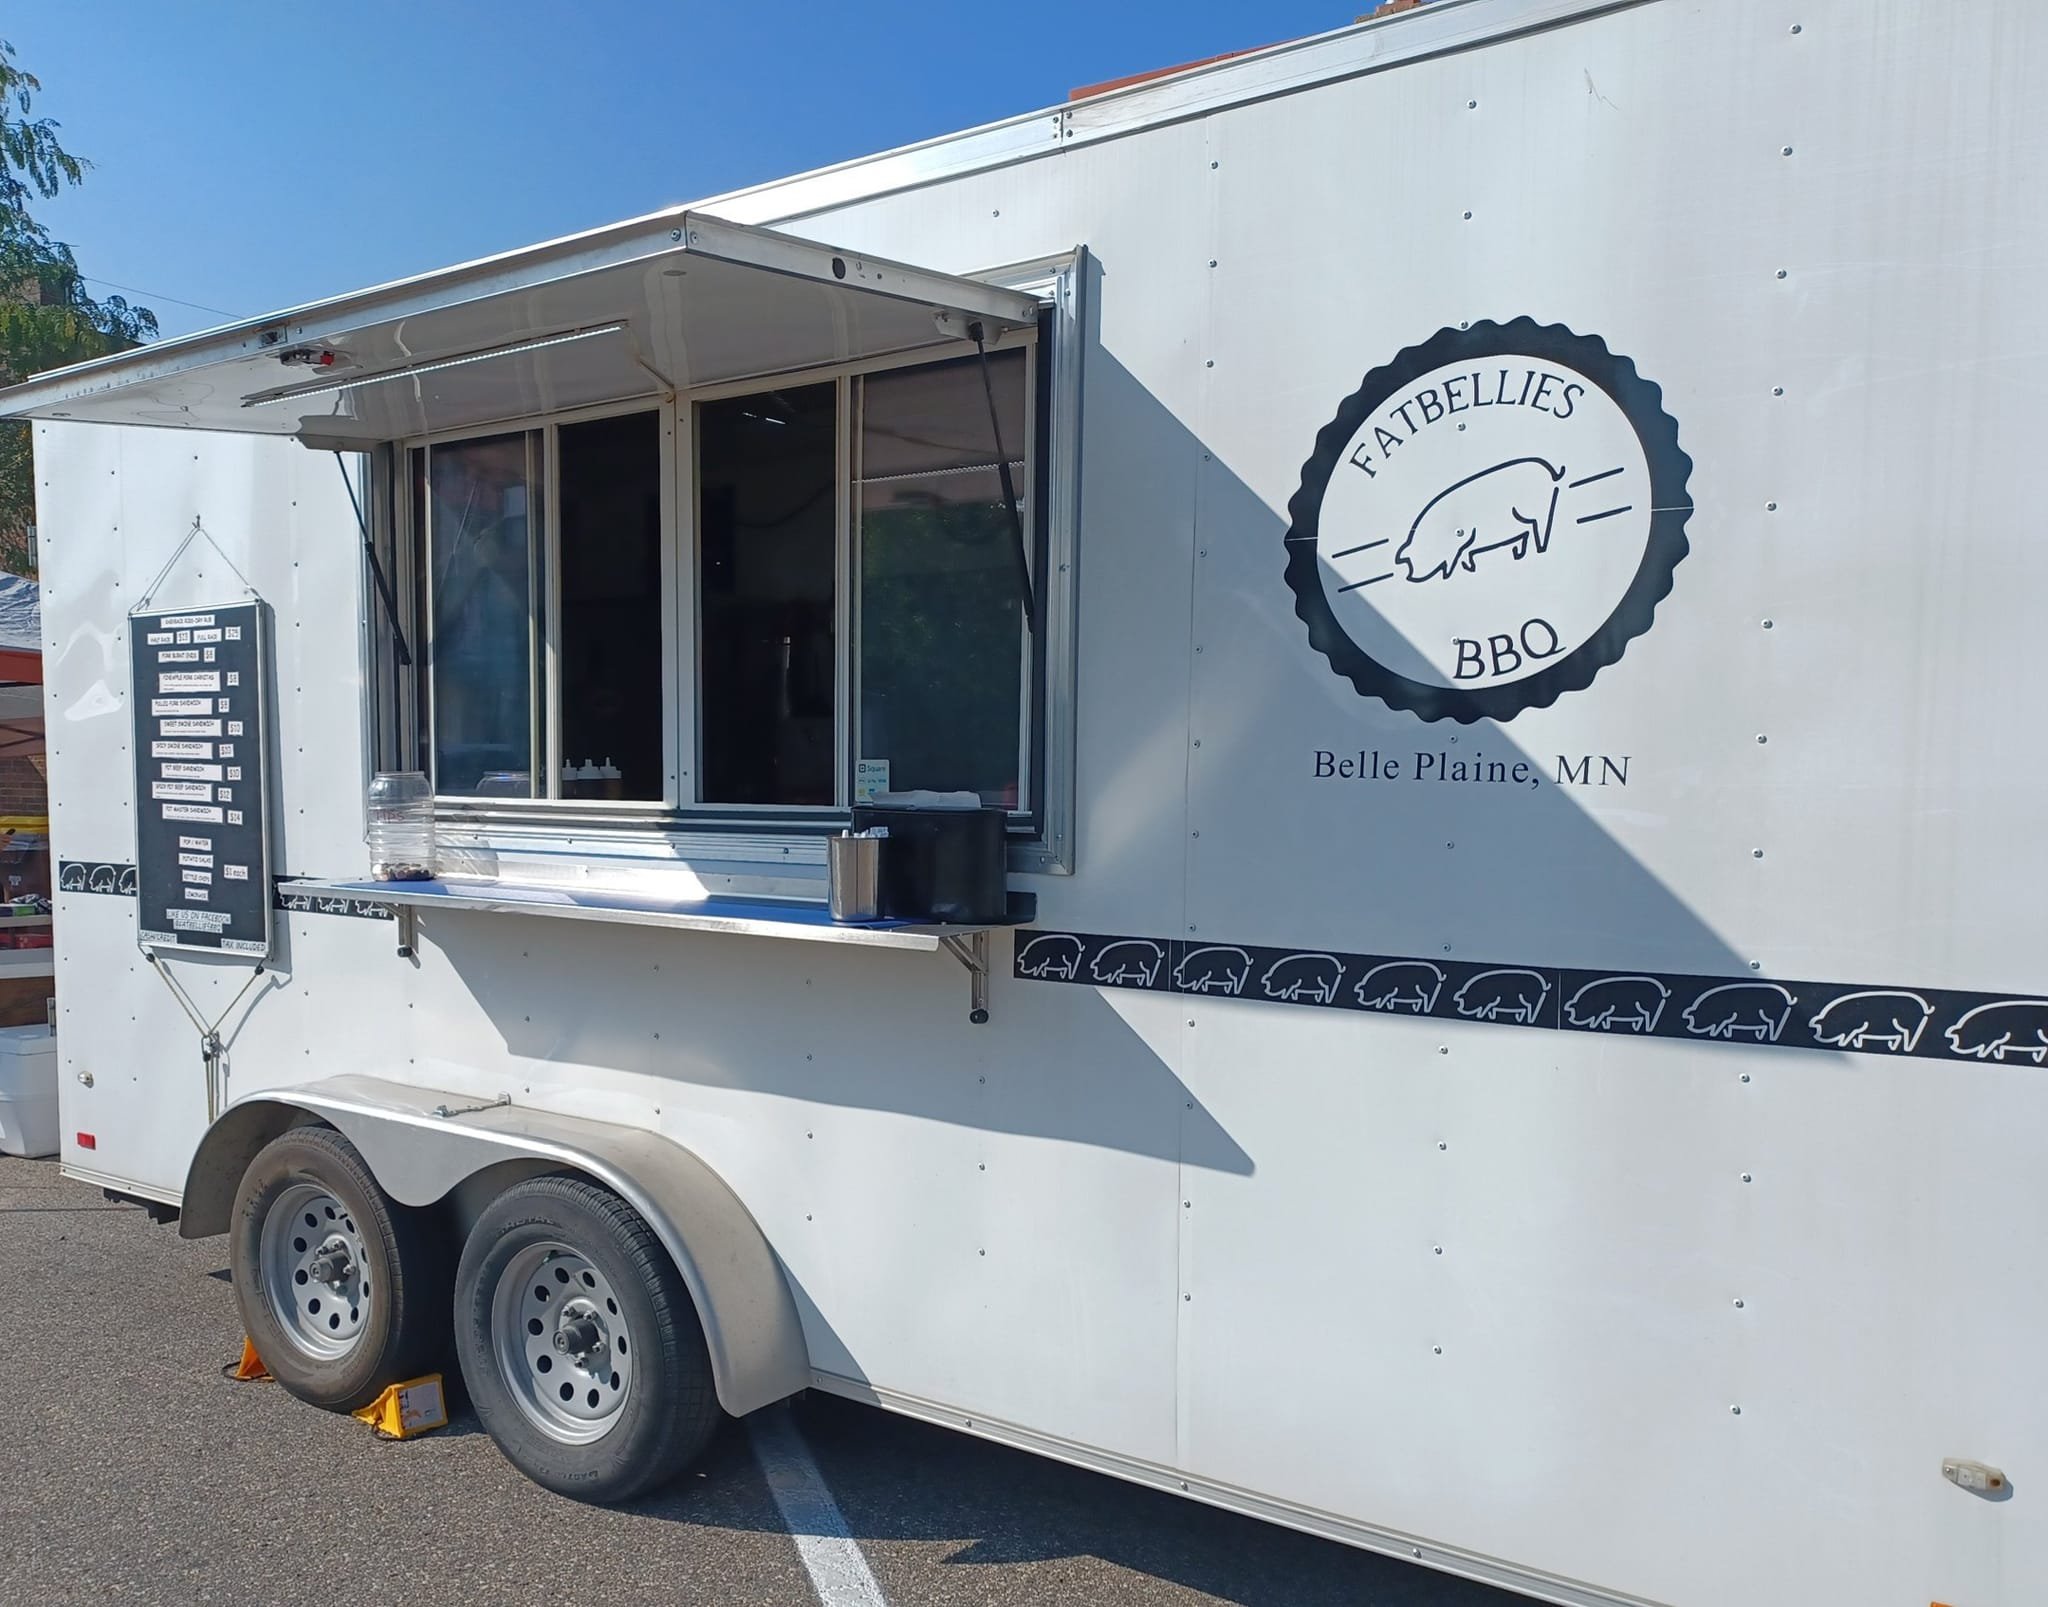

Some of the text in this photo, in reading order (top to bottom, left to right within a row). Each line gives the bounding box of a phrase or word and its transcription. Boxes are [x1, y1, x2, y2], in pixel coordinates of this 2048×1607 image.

[1349, 369, 1585, 479] FATBELLIES
[1453, 618, 1566, 680] BBQ
[1312, 750, 1632, 789] Belle Plaine, MN
[373, 808, 405, 823] TIPS
[167, 910, 180, 919] LIKE
[181, 911, 189, 919] US
[190, 911, 200, 920] ON
[222, 940, 266, 952] TAX INCLUDED
